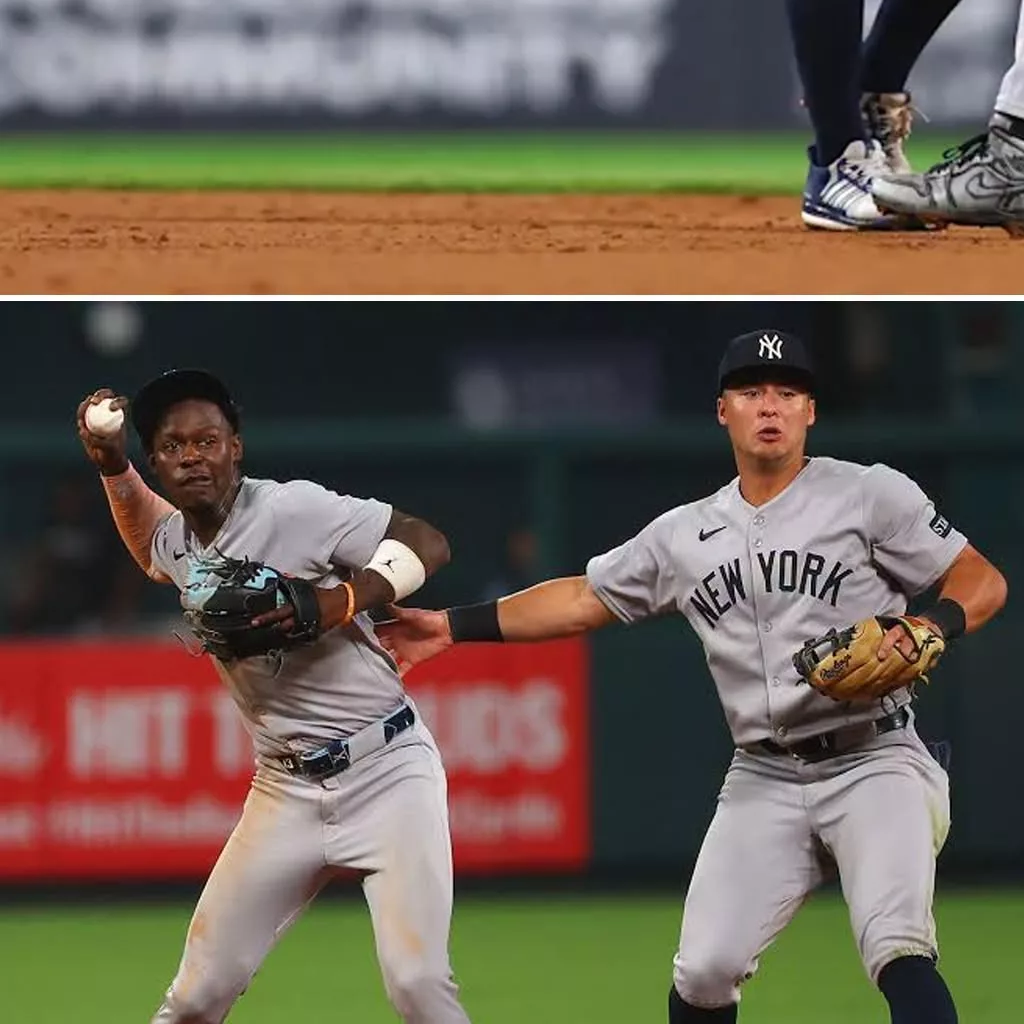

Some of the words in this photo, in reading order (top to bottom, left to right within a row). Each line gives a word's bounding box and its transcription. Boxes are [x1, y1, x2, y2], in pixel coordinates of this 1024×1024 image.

[0, 26, 666, 114] OMMUNITY
[758, 334, 783, 359] NY
[690, 558, 746, 630] NEW
[757, 550, 853, 606] YORK
